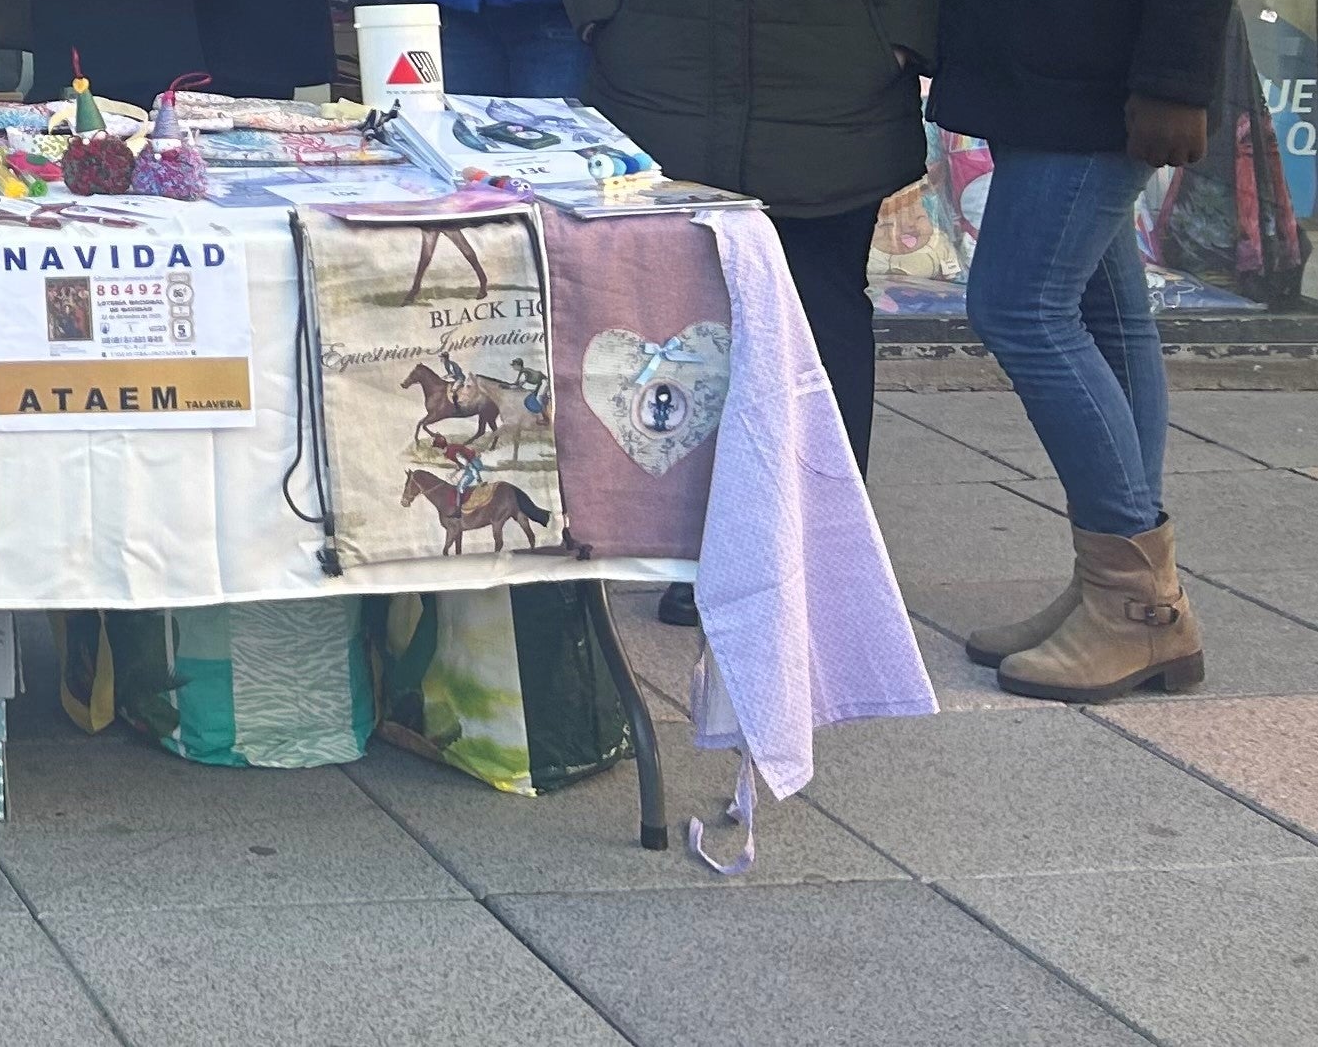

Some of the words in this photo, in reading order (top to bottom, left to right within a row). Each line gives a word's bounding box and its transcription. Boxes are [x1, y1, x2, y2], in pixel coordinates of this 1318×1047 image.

[1286, 121, 1317, 156] Q
[3, 243, 225, 271] NAVIDAD
[96, 283, 162, 296] 88492
[430, 301, 506, 328] BLACK
[321, 342, 428, 372] Equestrian
[18, 386, 178, 412] ATAEM
[185, 400, 242, 409] TALAVERA
